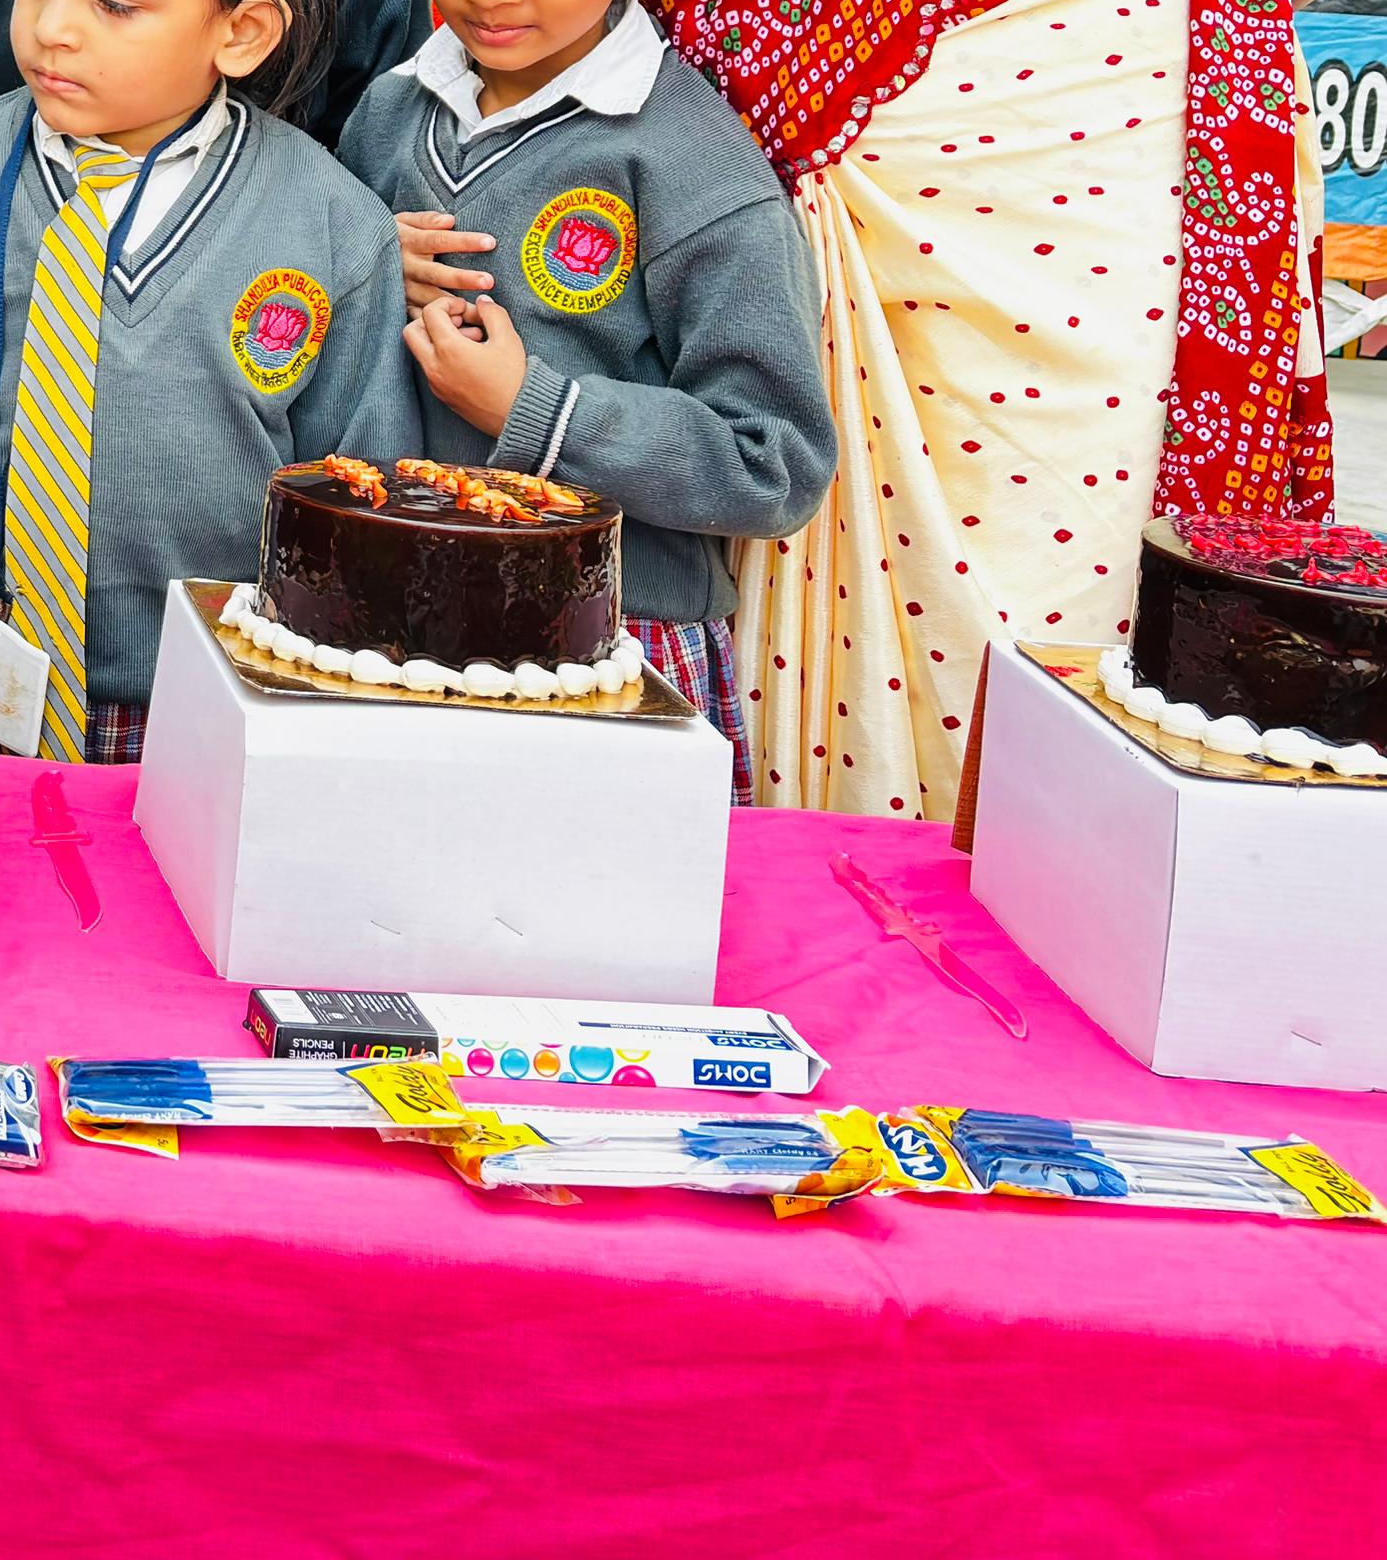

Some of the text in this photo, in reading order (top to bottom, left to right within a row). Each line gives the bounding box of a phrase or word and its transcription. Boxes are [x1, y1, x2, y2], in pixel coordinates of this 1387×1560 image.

[534, 191, 638, 271] SHANDILYA PUBLIC SCHOOL
[524, 231, 631, 311] EXCELLENCE EXEMPLIFIED
[234, 272, 332, 344] SHANDILYA PUBLIC SCHOOL
[250, 1009, 272, 1046] neon
[293, 1037, 335, 1049] PENCILS
[717, 1036, 787, 1049] DOMS
[393, 1065, 447, 1113] Goldy
[698, 1063, 768, 1084] DOMS
[1292, 1148, 1372, 1213] Goldy
